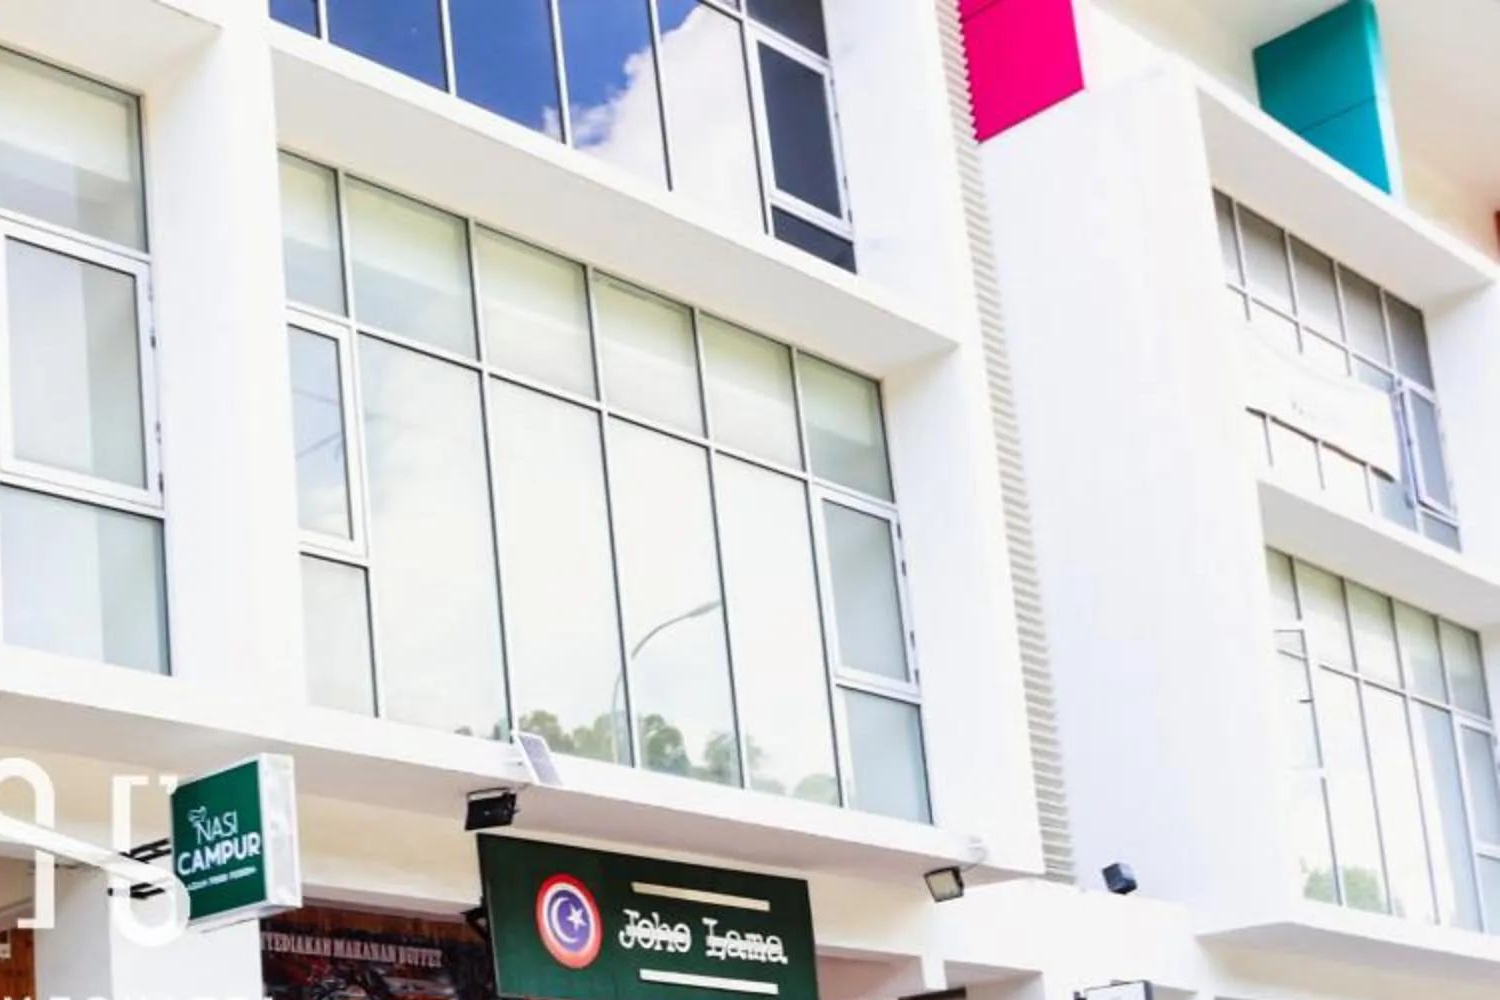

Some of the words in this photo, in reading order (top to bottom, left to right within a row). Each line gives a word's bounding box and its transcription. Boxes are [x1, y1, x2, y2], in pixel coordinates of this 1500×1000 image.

[196, 809, 238, 845] NASI
[177, 831, 261, 876] CAMPUR
[702, 916, 789, 964] Lama
